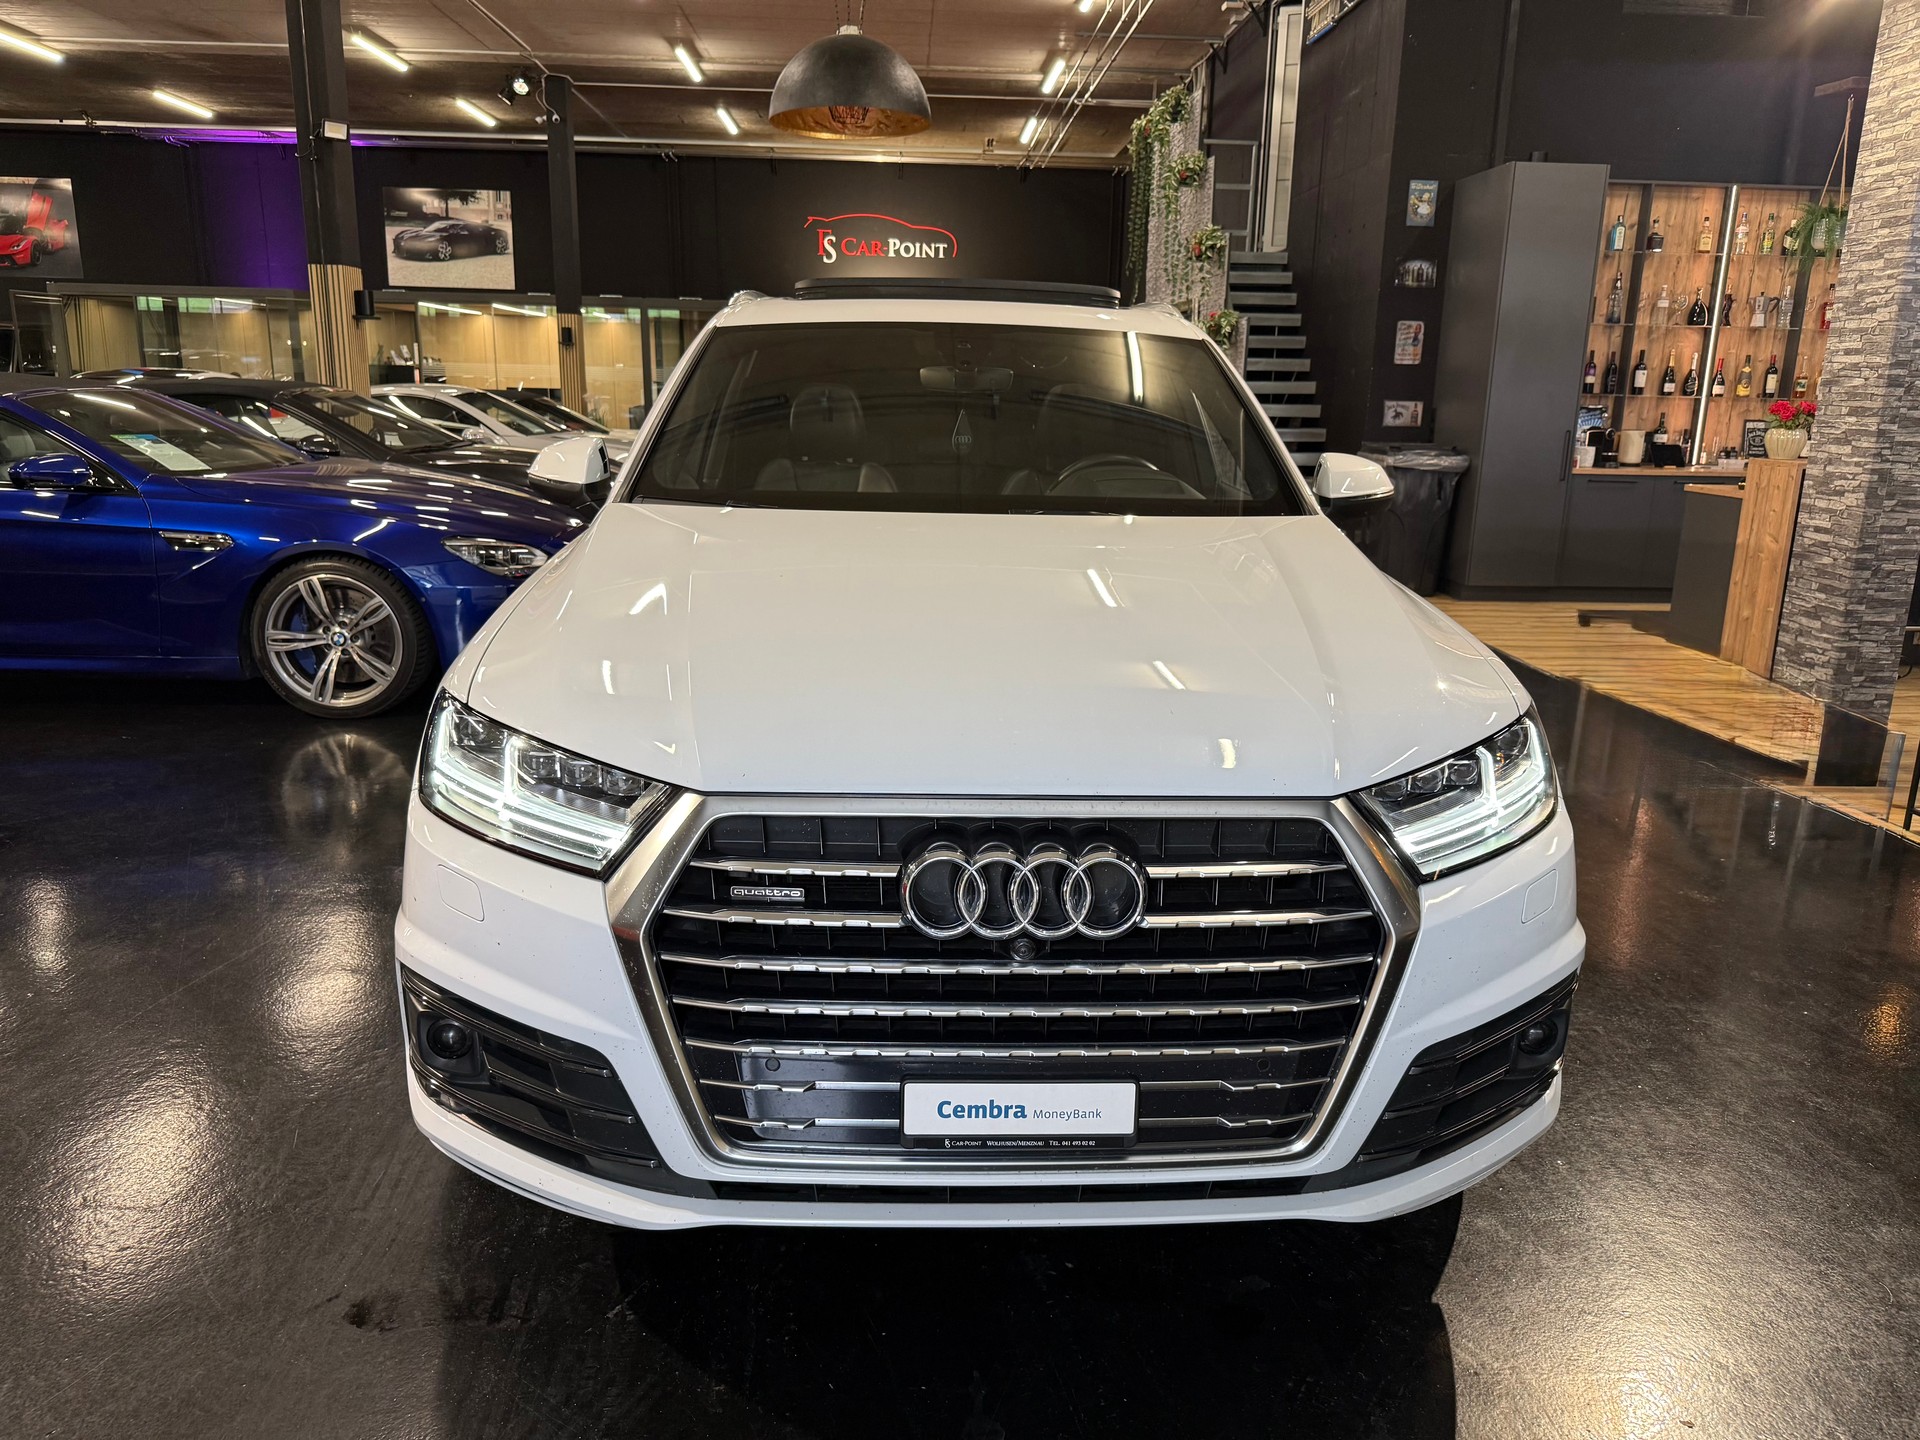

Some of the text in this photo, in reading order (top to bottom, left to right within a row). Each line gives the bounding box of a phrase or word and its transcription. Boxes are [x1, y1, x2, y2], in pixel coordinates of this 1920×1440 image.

[841, 237, 948, 259] CAR-POINT
[734, 889, 801, 897] quattro
[937, 1099, 1102, 1121] Cembra MoneyBank
